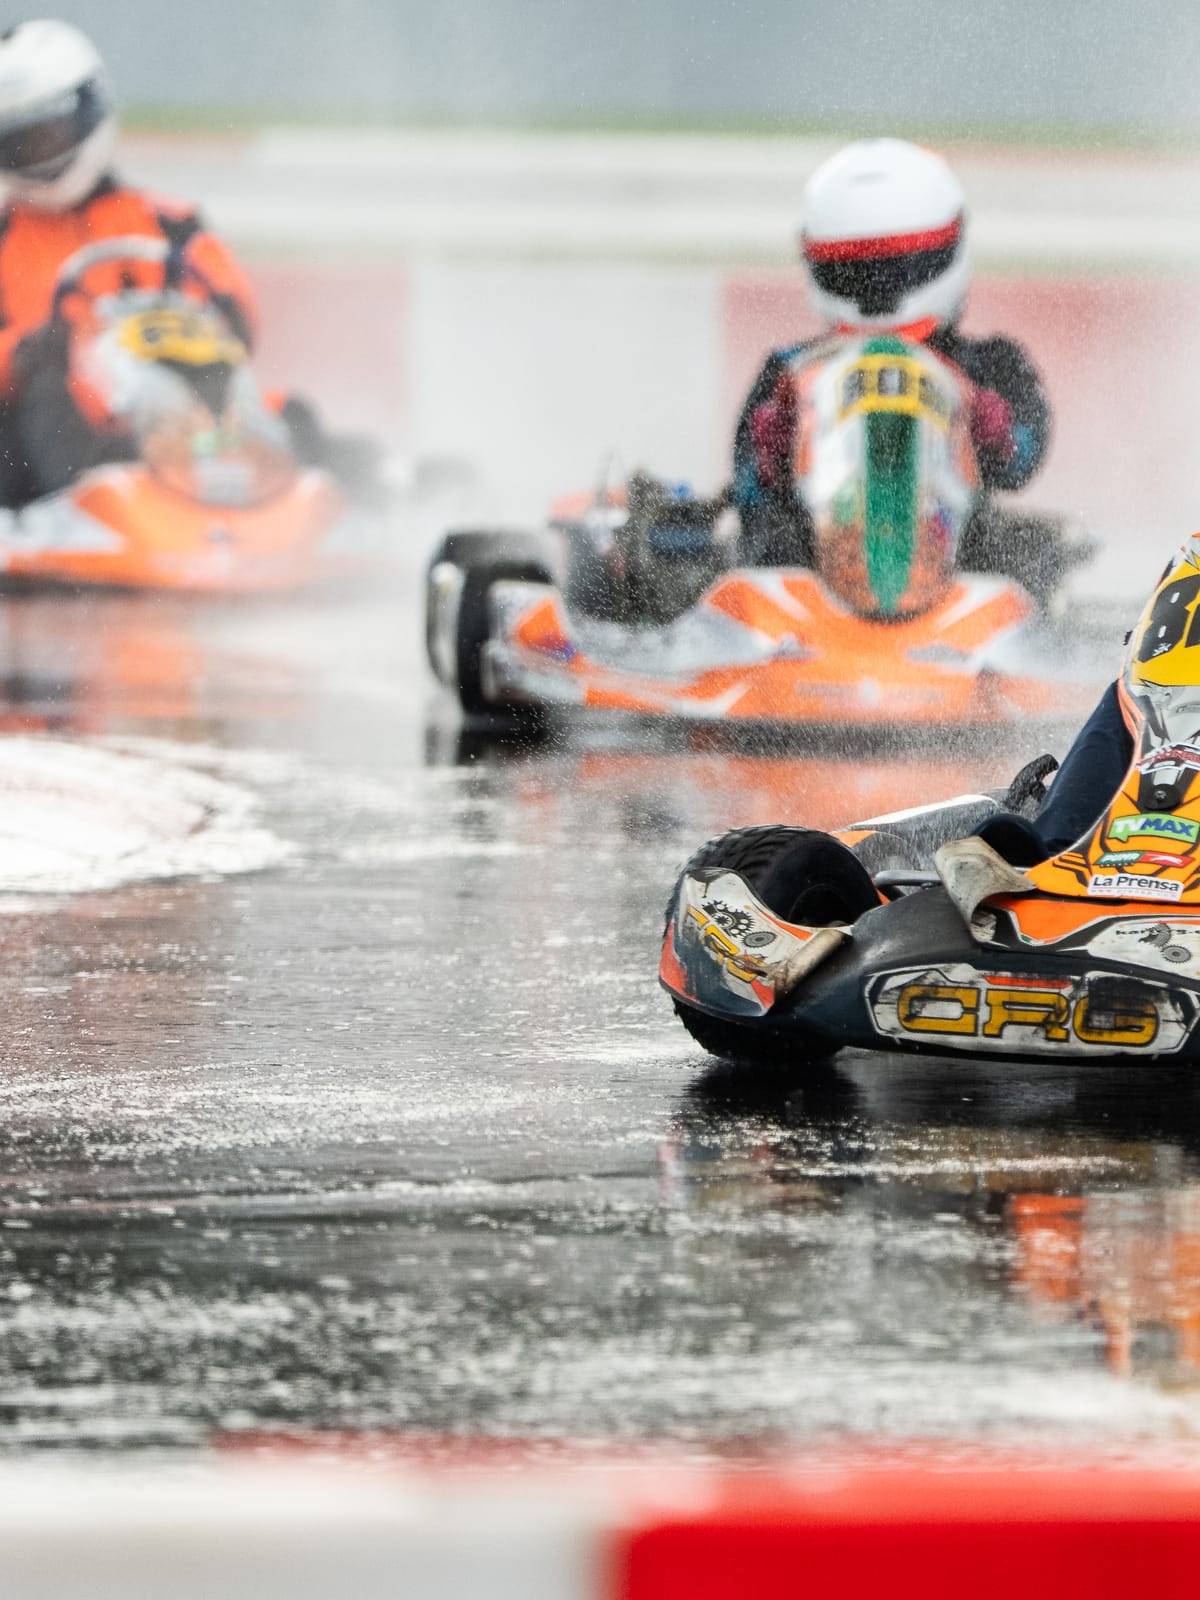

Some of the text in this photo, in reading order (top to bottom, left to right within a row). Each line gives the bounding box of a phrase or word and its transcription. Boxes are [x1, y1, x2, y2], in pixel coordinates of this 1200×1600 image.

[1092, 876, 1180, 892] La Prensa
[898, 983, 1160, 1047] CRG
